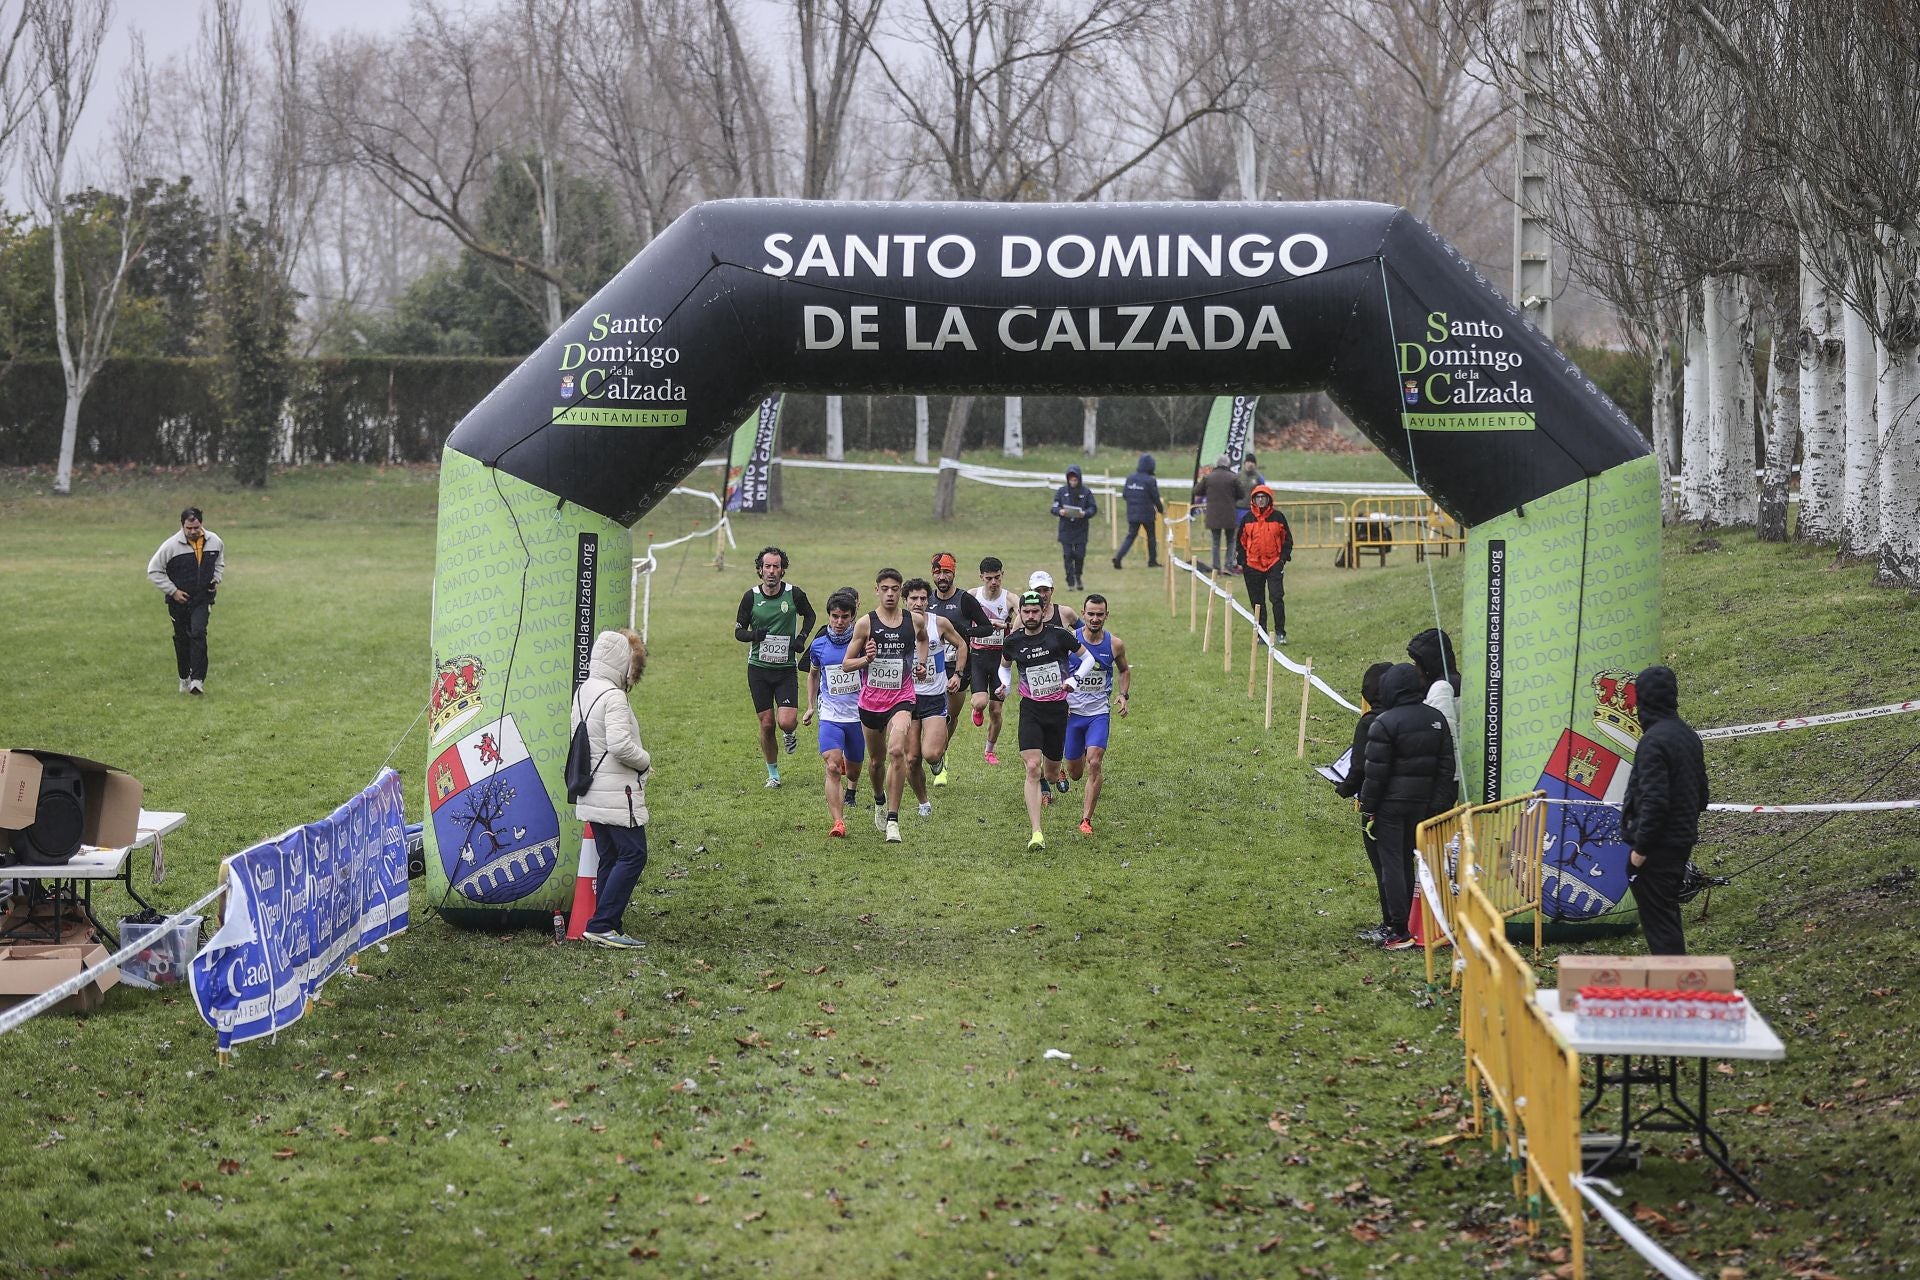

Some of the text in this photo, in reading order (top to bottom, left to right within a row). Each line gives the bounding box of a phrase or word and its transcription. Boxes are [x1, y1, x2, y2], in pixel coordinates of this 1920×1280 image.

[762, 232, 1329, 279] SANTO DOMINGO
[588, 313, 663, 342] Santo
[803, 305, 1292, 352] DE LA CALZADA
[1426, 311, 1504, 343] Santo
[559, 340, 680, 371] Domingo
[1397, 342, 1523, 374] Domingo
[580, 368, 688, 401] Calzada
[609, 365, 634, 376] de la
[1454, 369, 1480, 380] de la
[1424, 372, 1535, 405] Calzada
[561, 411, 680, 423] AYUNTAMIENTO
[1409, 416, 1528, 427] AYUNTAMIENTO
[758, 465, 769, 482] LA
[756, 485, 767, 501] DE
[1507, 507, 1594, 543] DOMINGO
[1600, 498, 1621, 517] DE
[467, 545, 486, 563] DE
[490, 539, 507, 556] LA
[1541, 527, 1600, 554] SANTO
[484, 547, 572, 577] DOMINGO
[1525, 564, 1545, 581] LA
[1549, 545, 1625, 574] CALZADA
[1519, 569, 1609, 601] DOMINGO
[1613, 564, 1632, 580] DE
[476, 607, 497, 624] DE
[502, 601, 522, 619] LA
[576, 543, 596, 686] ingodelacalzada.org
[1557, 589, 1615, 616] SANTO
[1513, 607, 1636, 650] DE LA CALZADA
[447, 631, 492, 656] SANTO
[762, 643, 787, 655] 3029
[1534, 632, 1623, 667] DOMINGO
[514, 665, 535, 682] LA
[829, 673, 856, 685] 3027
[871, 668, 898, 679] 3049
[1031, 673, 1058, 687] 3040
[1486, 550, 1504, 803] www.santodomingodelacalzada.org
[1528, 694, 1550, 713] DE
[255, 863, 276, 893] Santo
